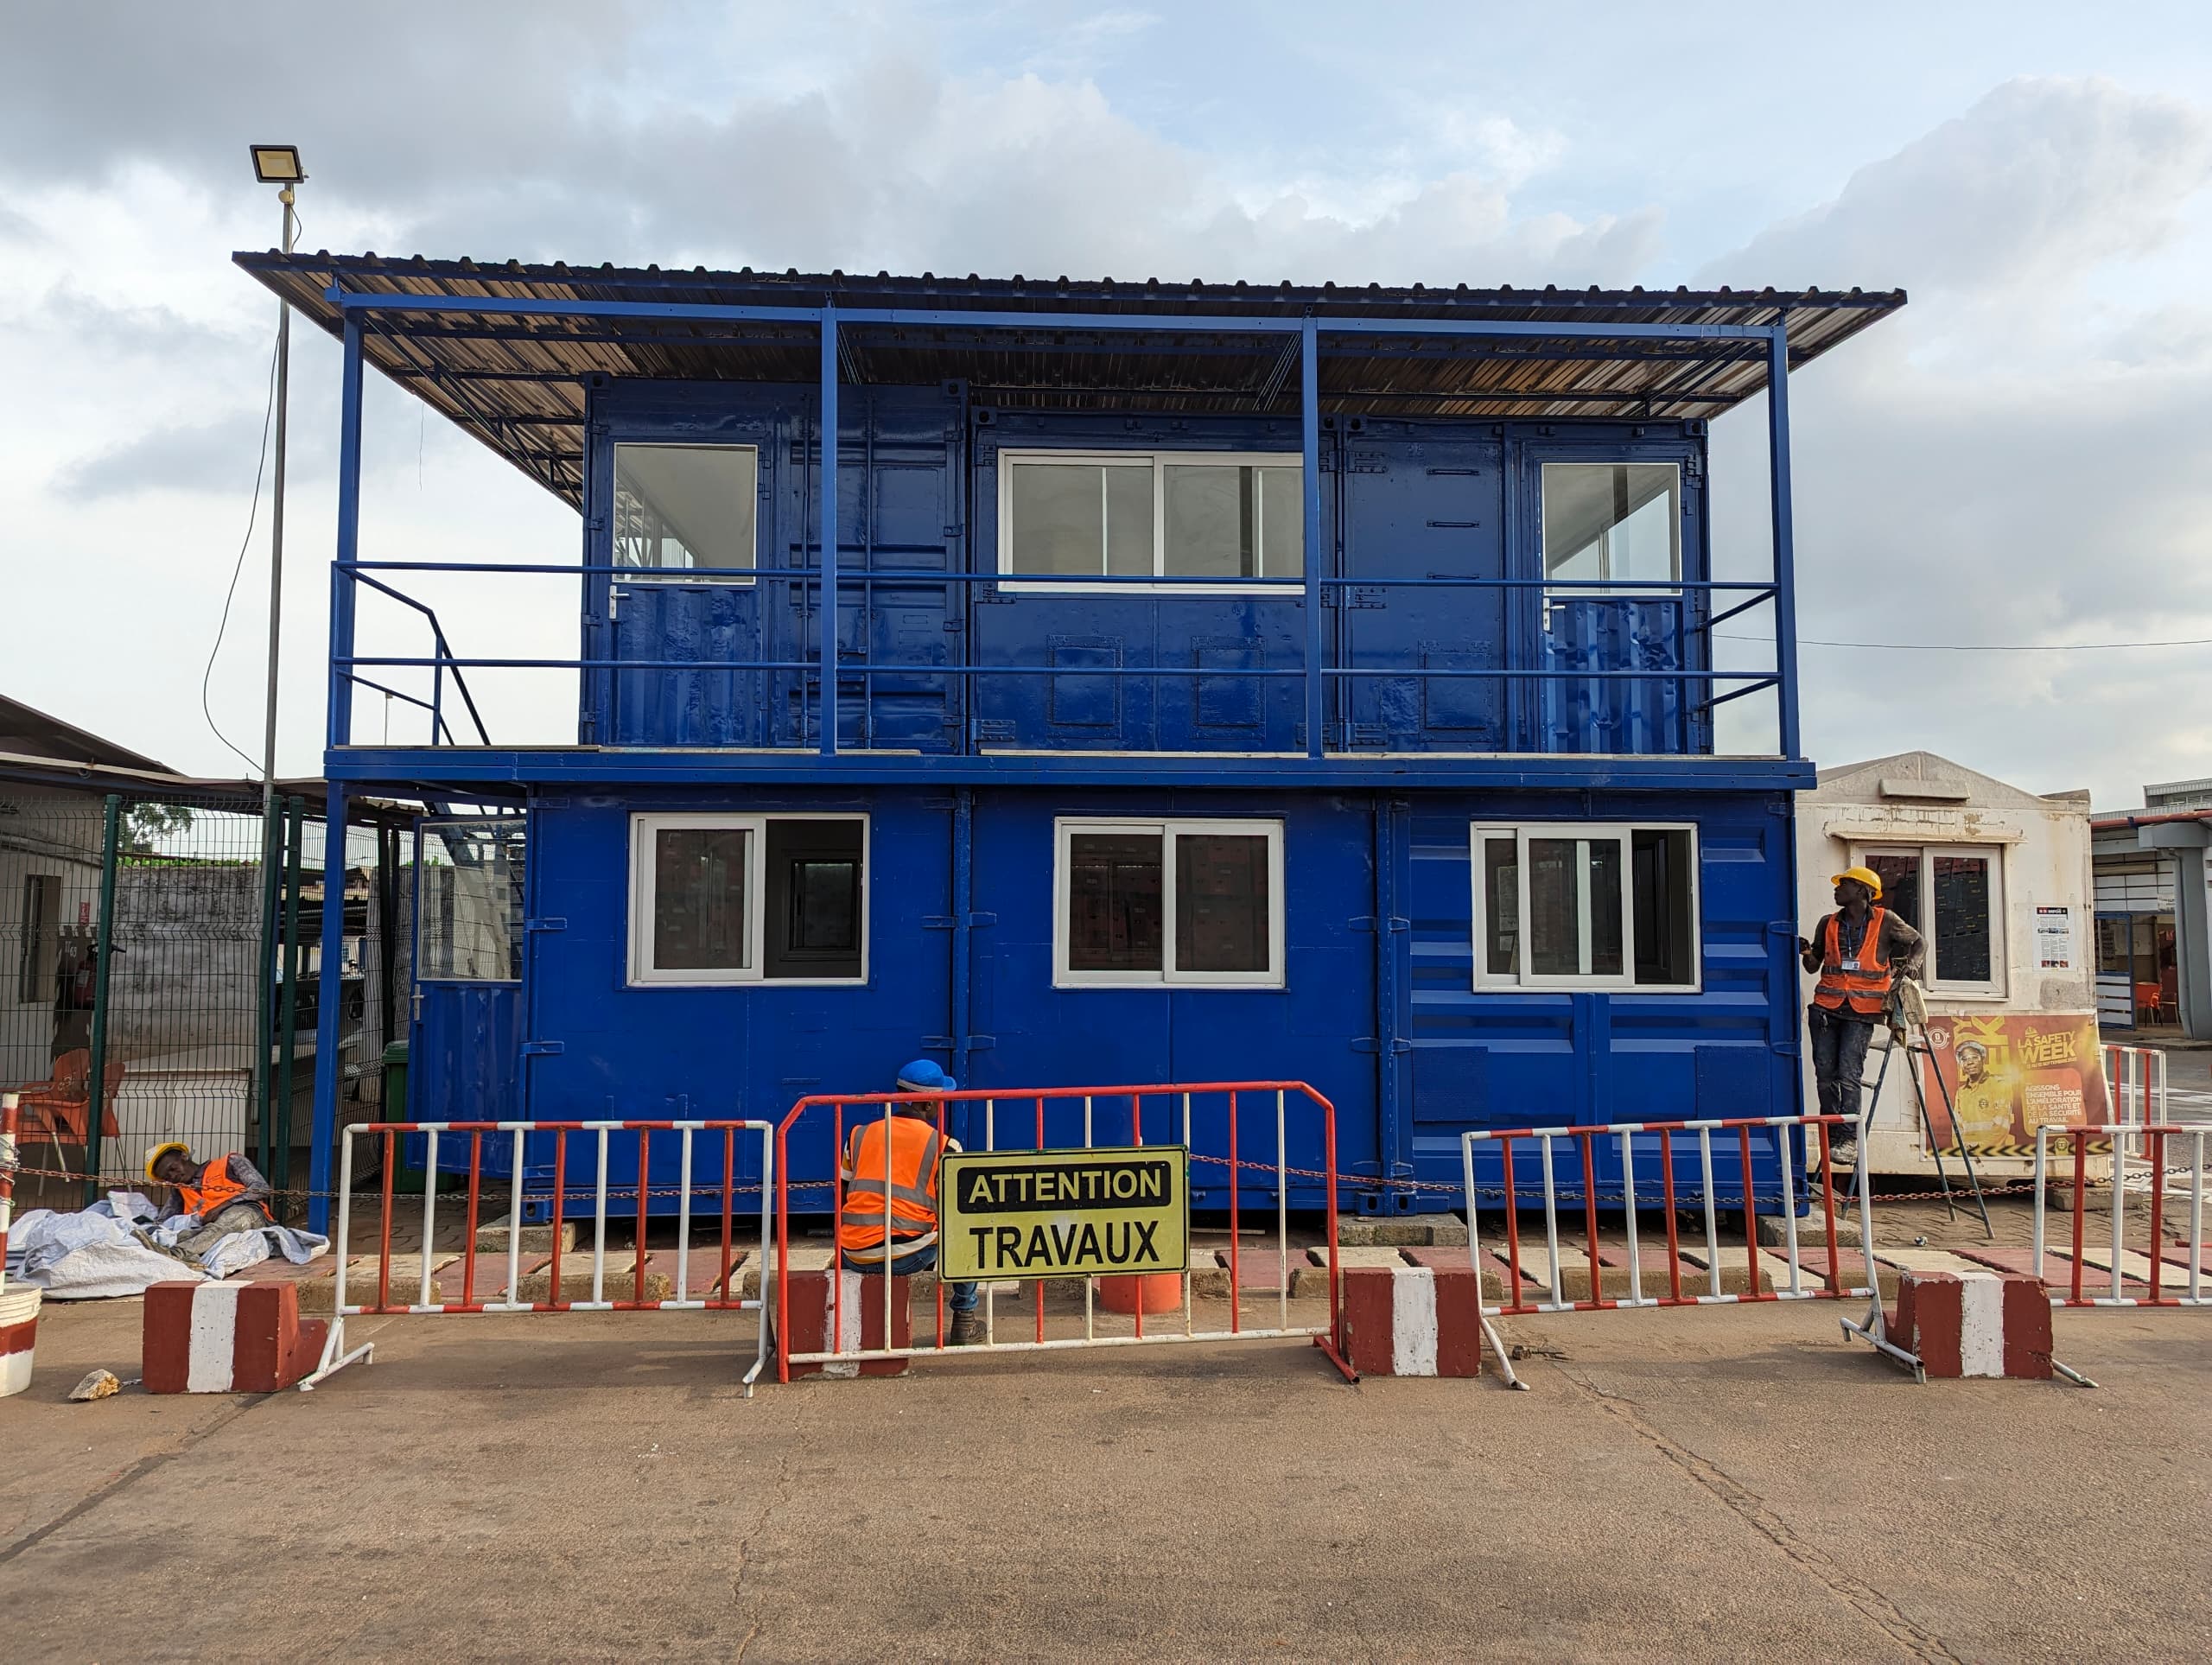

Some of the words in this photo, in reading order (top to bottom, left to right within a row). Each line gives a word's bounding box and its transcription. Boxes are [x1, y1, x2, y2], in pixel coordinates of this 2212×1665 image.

[2018, 1038, 2033, 1049] LA
[2034, 1031, 2075, 1046] SAFETY
[2018, 1040, 2076, 1064] WEEK
[969, 1169, 1160, 1204] ATTENTION
[969, 1221, 1160, 1268] TRAVAUX
